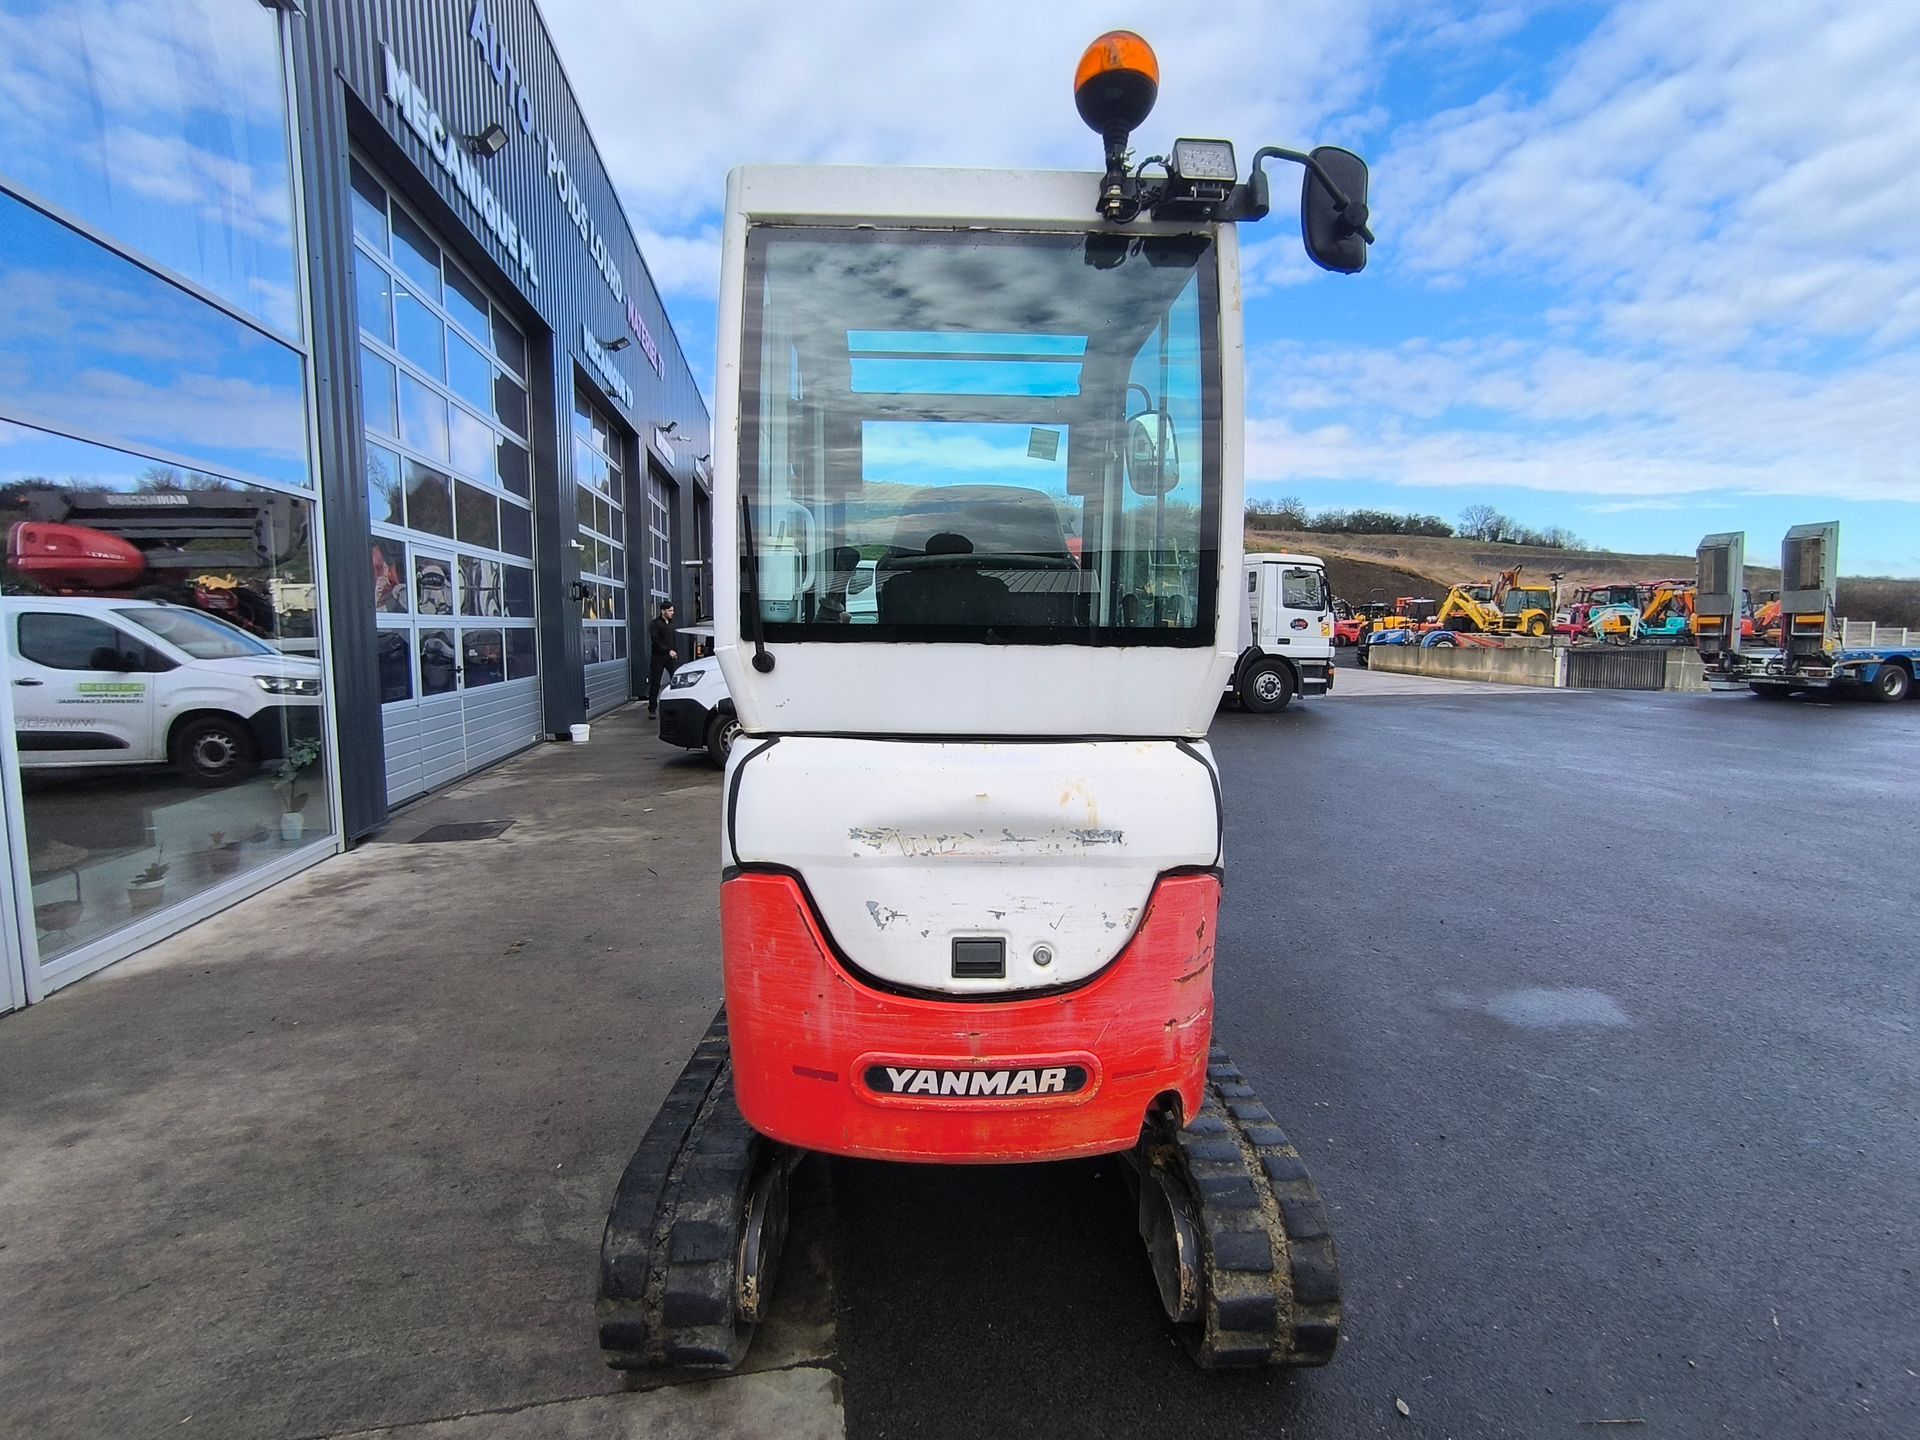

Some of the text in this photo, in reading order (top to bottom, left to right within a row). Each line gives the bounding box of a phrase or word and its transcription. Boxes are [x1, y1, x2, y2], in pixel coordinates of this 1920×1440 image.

[383, 43, 540, 288] MECANIQUE PL
[470, 0, 532, 136] AUTO
[546, 138, 588, 242] POIDS
[590, 222, 622, 303] LOURD
[885, 1067, 1067, 1096] YANMAR
